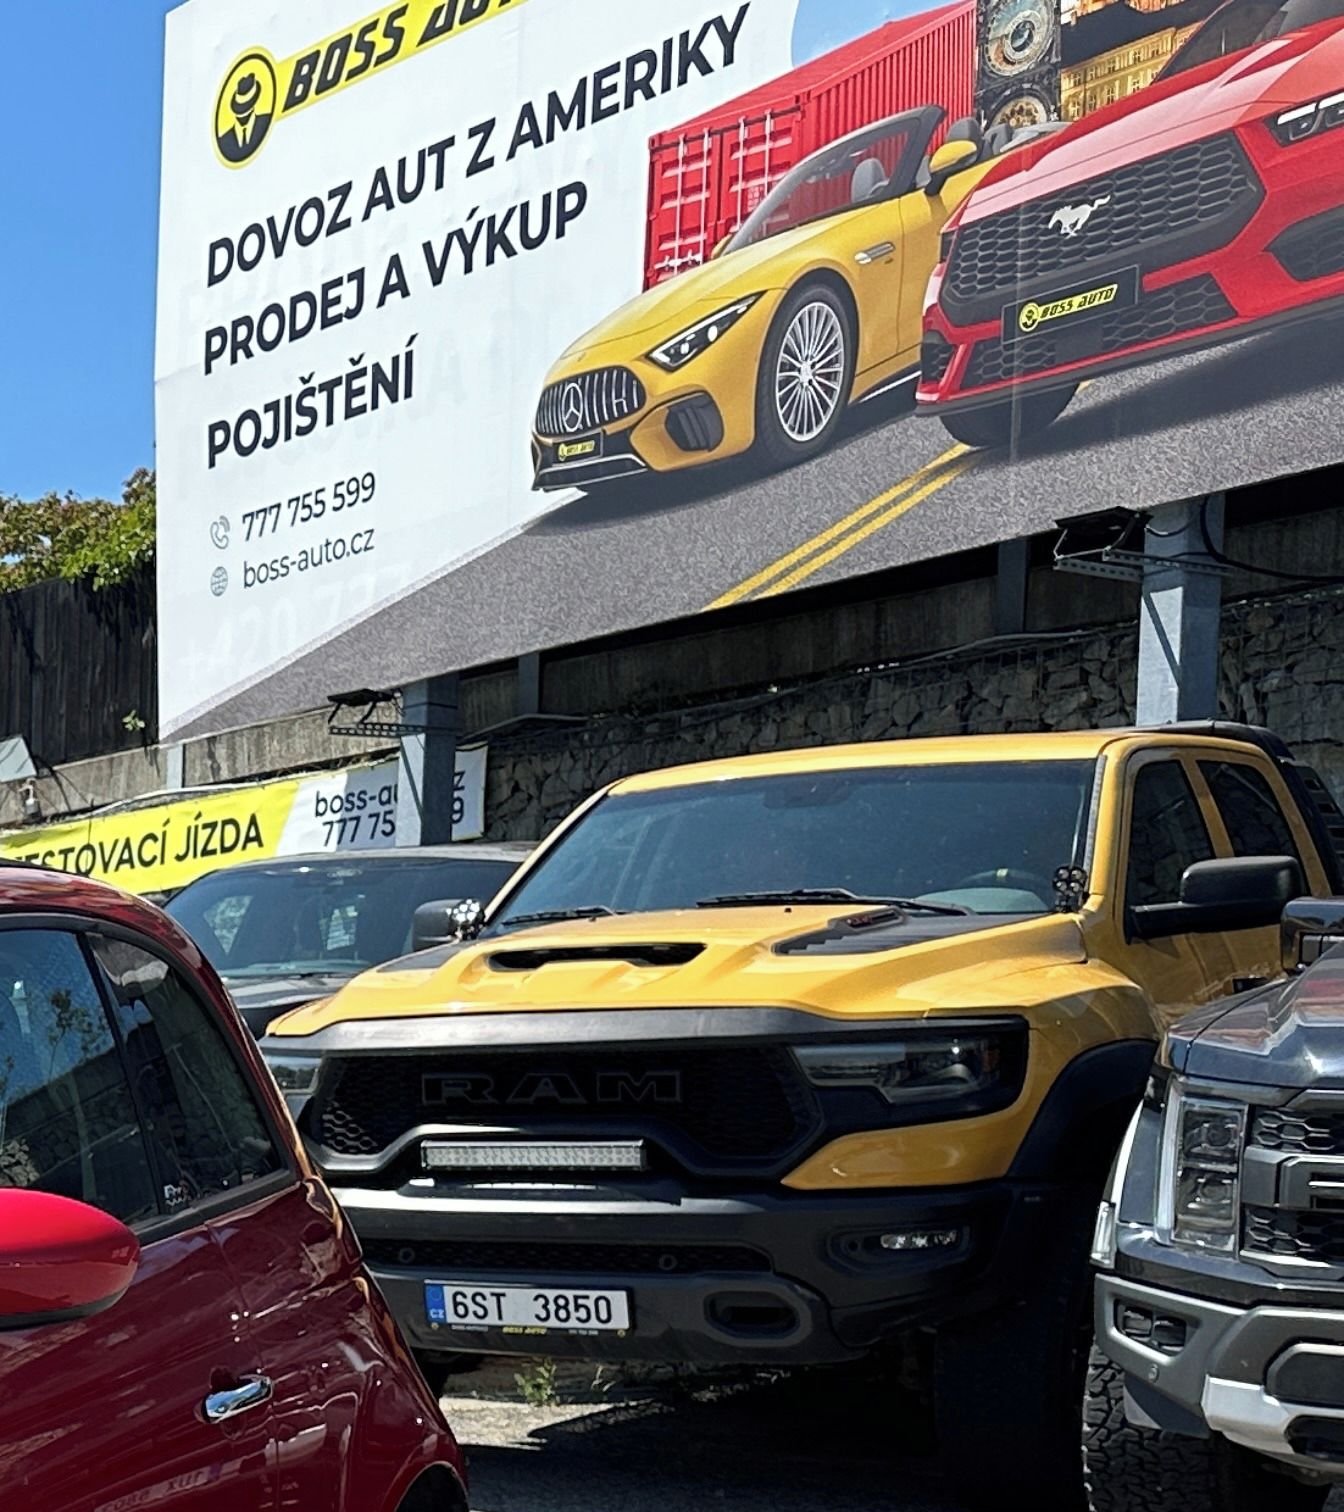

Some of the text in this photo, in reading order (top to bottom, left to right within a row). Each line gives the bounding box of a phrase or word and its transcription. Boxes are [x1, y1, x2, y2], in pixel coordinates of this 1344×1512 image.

[282, 3, 409, 112] BOSS
[207, 1, 752, 288] DOVOZ AUT Z AMERIKY
[204, 180, 588, 375] PRODEJ A VÝKUP
[1040, 287, 1114, 319] BOSS AUTO
[207, 333, 419, 470] POJIŠTĚNÍ
[242, 471, 376, 542] 777 755 599
[243, 527, 376, 590] boss-auto.cz
[174, 811, 264, 862] JÍZDA
[322, 816, 361, 847] 777
[421, 1071, 681, 1104] RAM
[430, 1291, 612, 1324] CZ 6ST 3850
